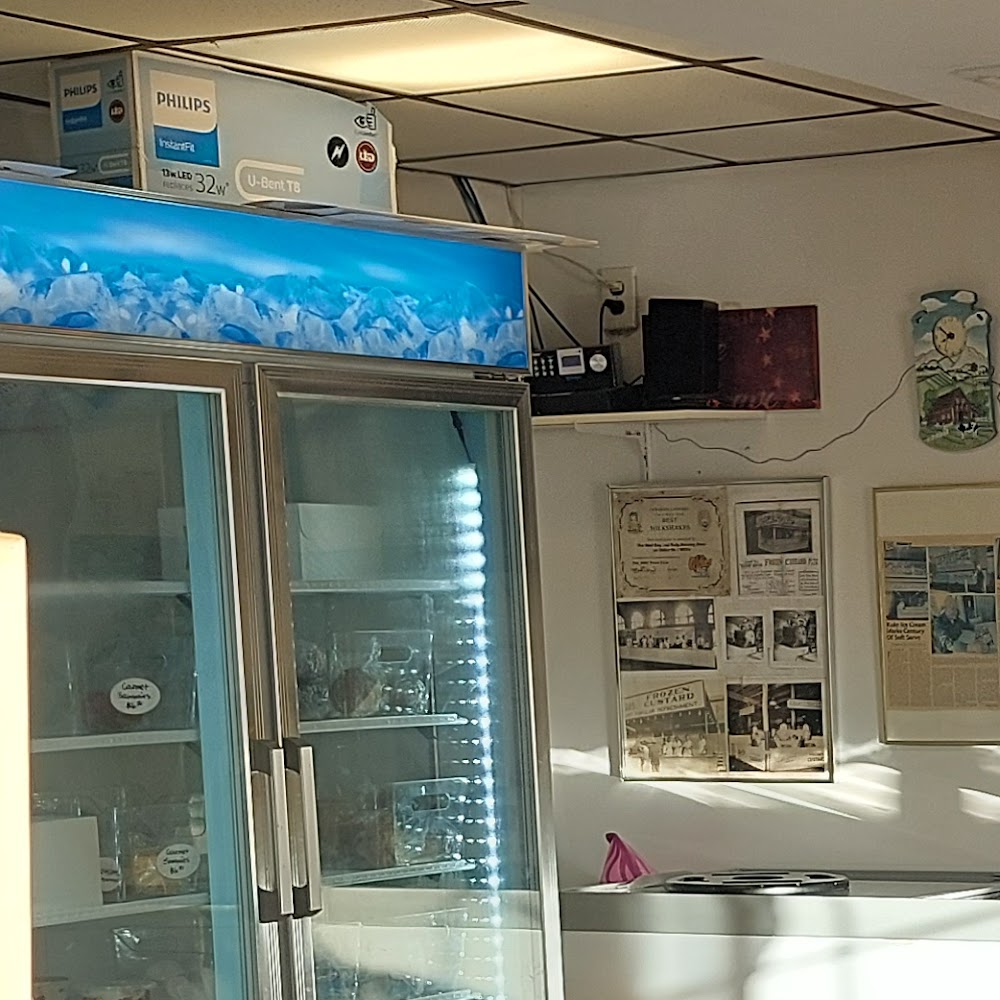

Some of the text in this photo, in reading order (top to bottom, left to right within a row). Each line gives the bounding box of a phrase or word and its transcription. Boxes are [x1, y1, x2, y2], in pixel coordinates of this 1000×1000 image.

[64, 84, 97, 98] PHILIPS
[157, 92, 211, 114] PHILIPS
[158, 138, 195, 153] InstantFit
[177, 171, 193, 181] LED
[247, 174, 286, 192] U-Bent
[643, 693, 695, 707] CUSTARD
[646, 686, 690, 700] FROZEN
